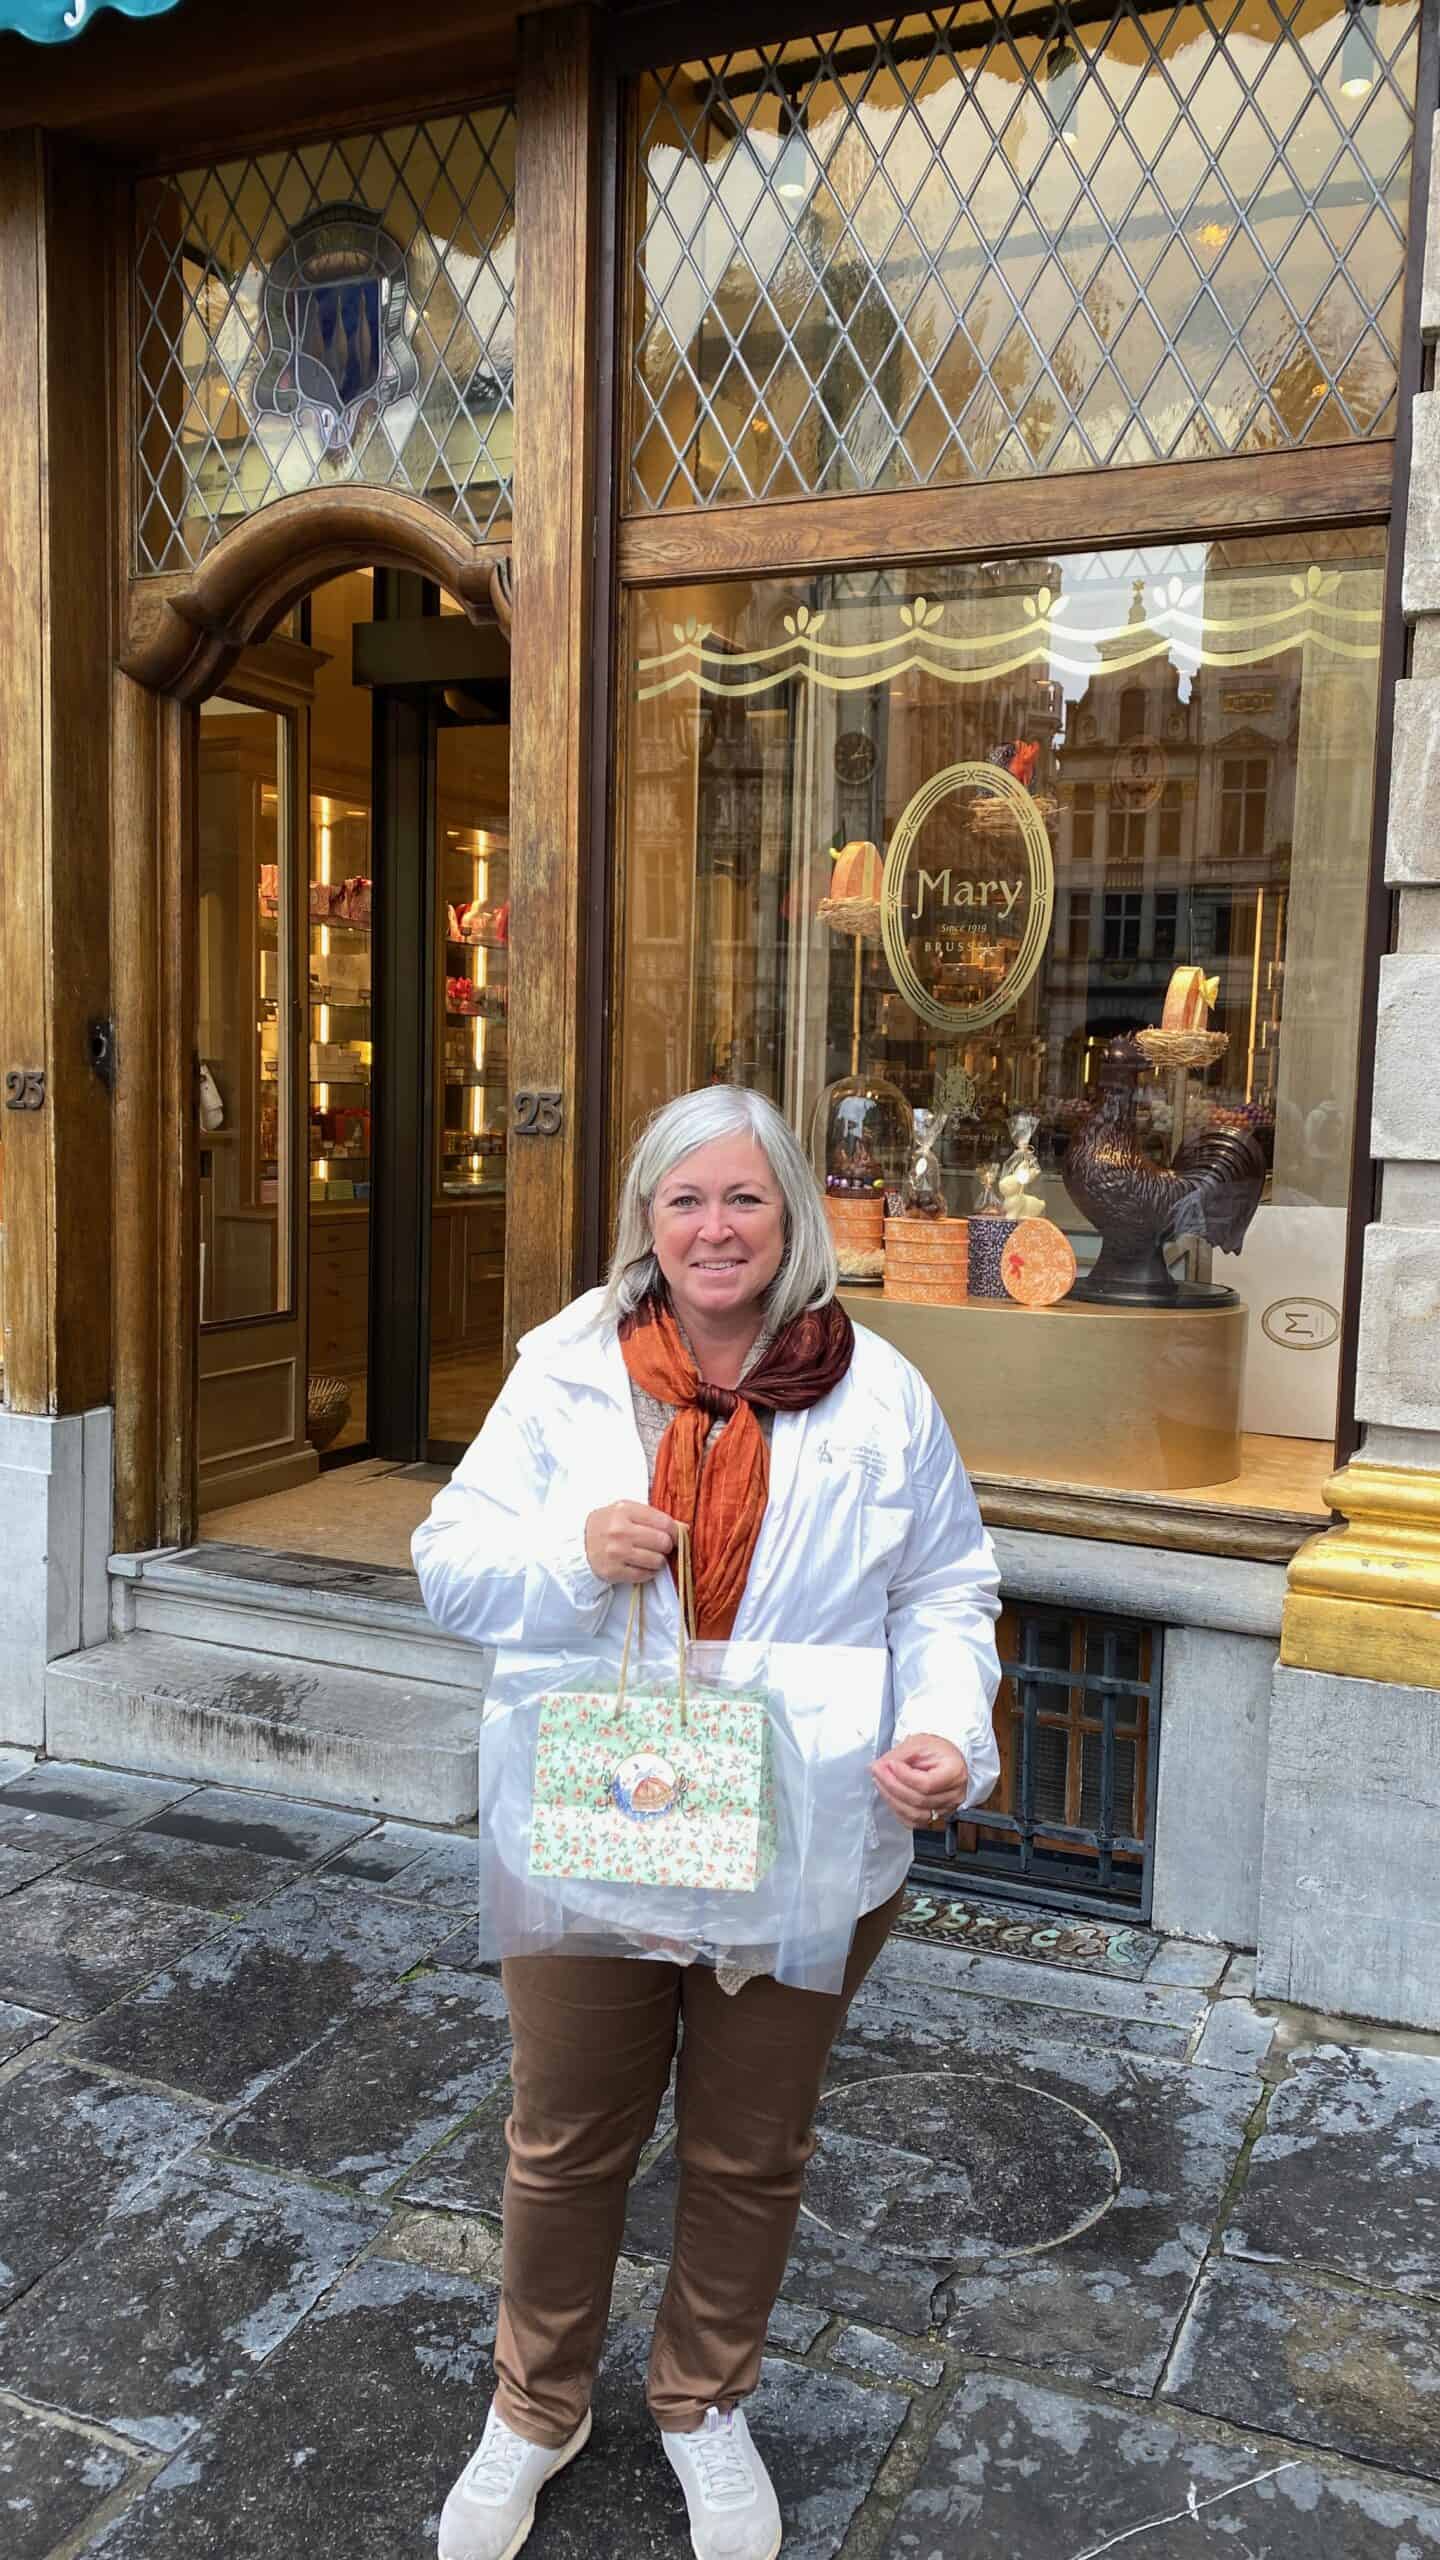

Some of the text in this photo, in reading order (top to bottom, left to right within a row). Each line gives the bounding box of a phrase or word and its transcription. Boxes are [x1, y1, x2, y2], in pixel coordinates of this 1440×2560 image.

[911, 869, 1022, 920] Mary
[941, 923, 965, 934] Since
[514, 1091, 562, 1136] 23
